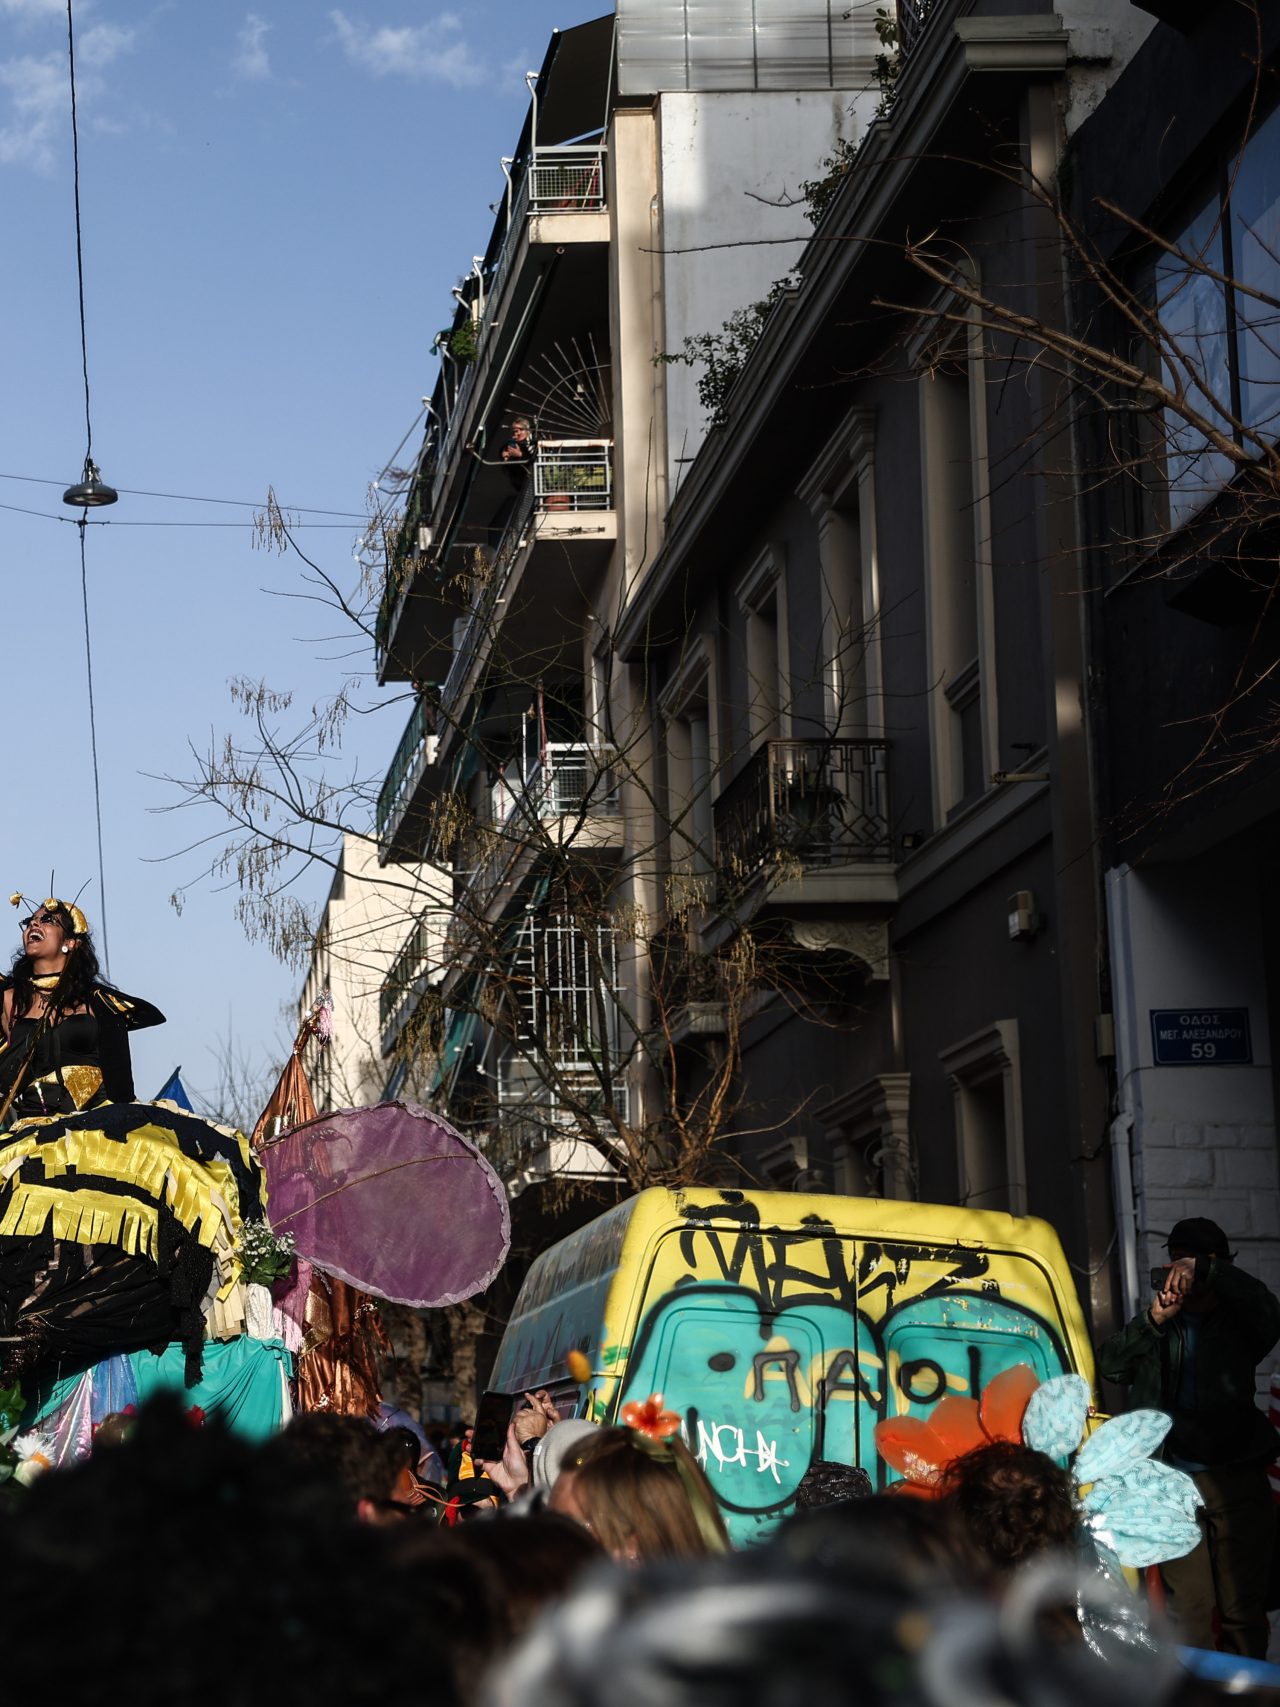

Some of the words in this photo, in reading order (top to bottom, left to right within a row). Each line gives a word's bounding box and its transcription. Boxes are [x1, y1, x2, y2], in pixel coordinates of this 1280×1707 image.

[1179, 1015, 1222, 1025] ΟΔΟΣ
[1160, 1029, 1180, 1040] ΜΕΓ.
[1182, 1028, 1243, 1040] ΑΛΕΞΑΝΔΡΟΥ
[1191, 1042, 1217, 1059] 59
